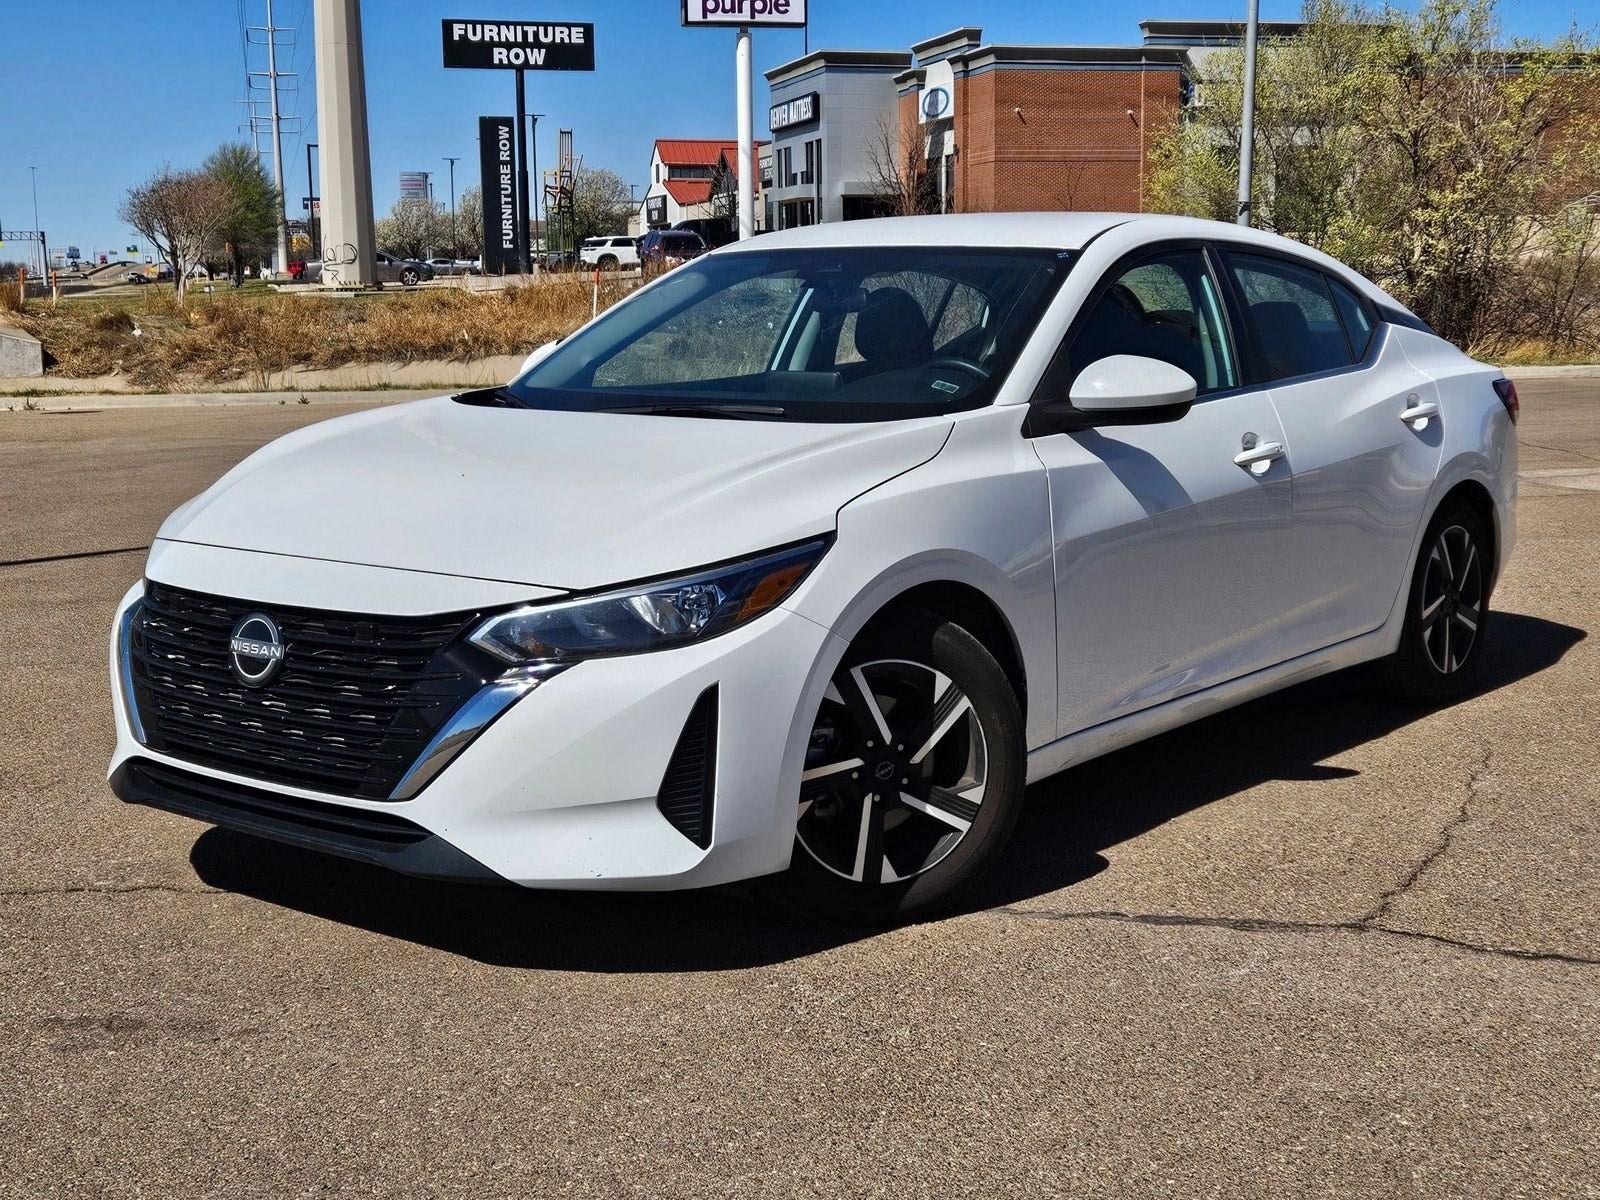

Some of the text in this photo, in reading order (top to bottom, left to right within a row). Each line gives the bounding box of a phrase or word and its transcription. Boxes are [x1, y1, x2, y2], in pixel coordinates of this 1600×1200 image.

[702, 0, 790, 19] purple
[453, 23, 585, 43] FURNITURE
[493, 47, 546, 64] ROW
[770, 96, 812, 129] DENVER MATTRESS
[498, 125, 514, 249] FURNITURE ROW
[231, 639, 281, 657] NISSAN
